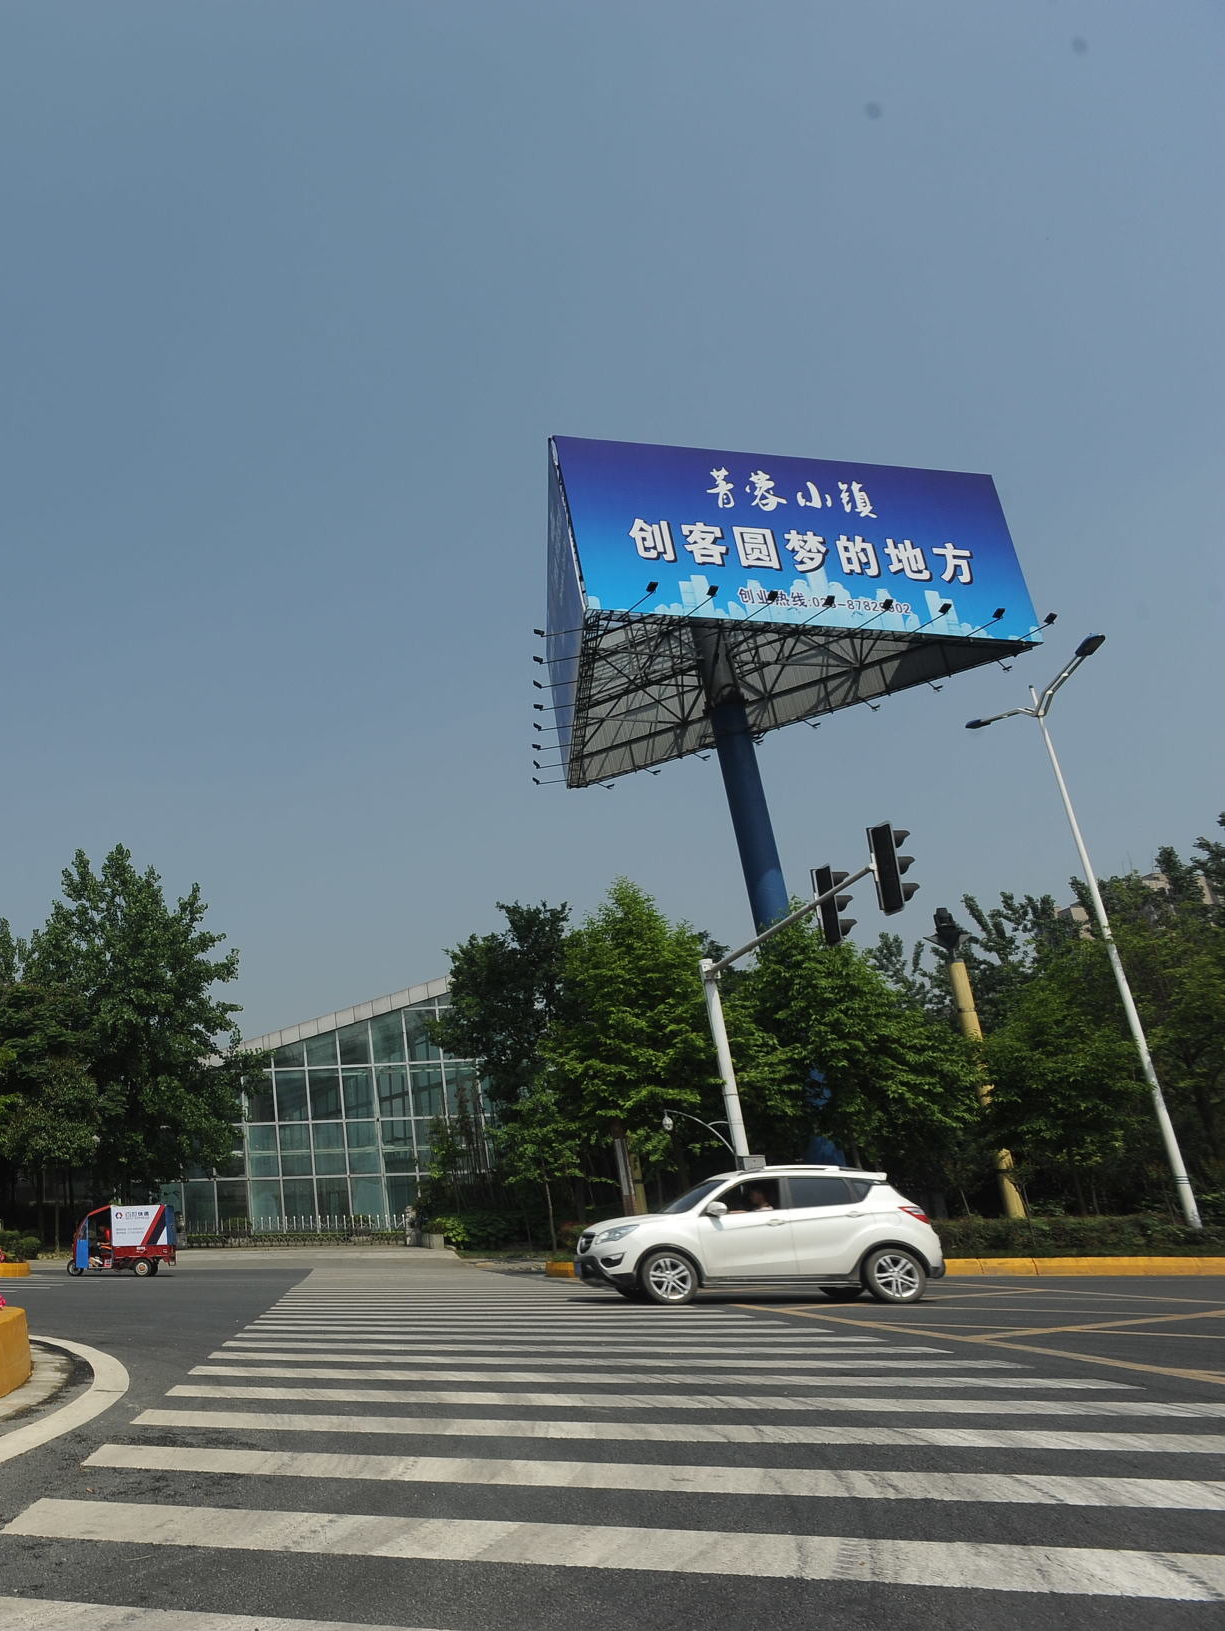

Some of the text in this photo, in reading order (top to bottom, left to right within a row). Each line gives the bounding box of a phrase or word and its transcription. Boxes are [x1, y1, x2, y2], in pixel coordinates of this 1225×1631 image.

[706, 466, 878, 519] 菁蓉小镇
[628, 517, 975, 585] 创客圆梦的地方
